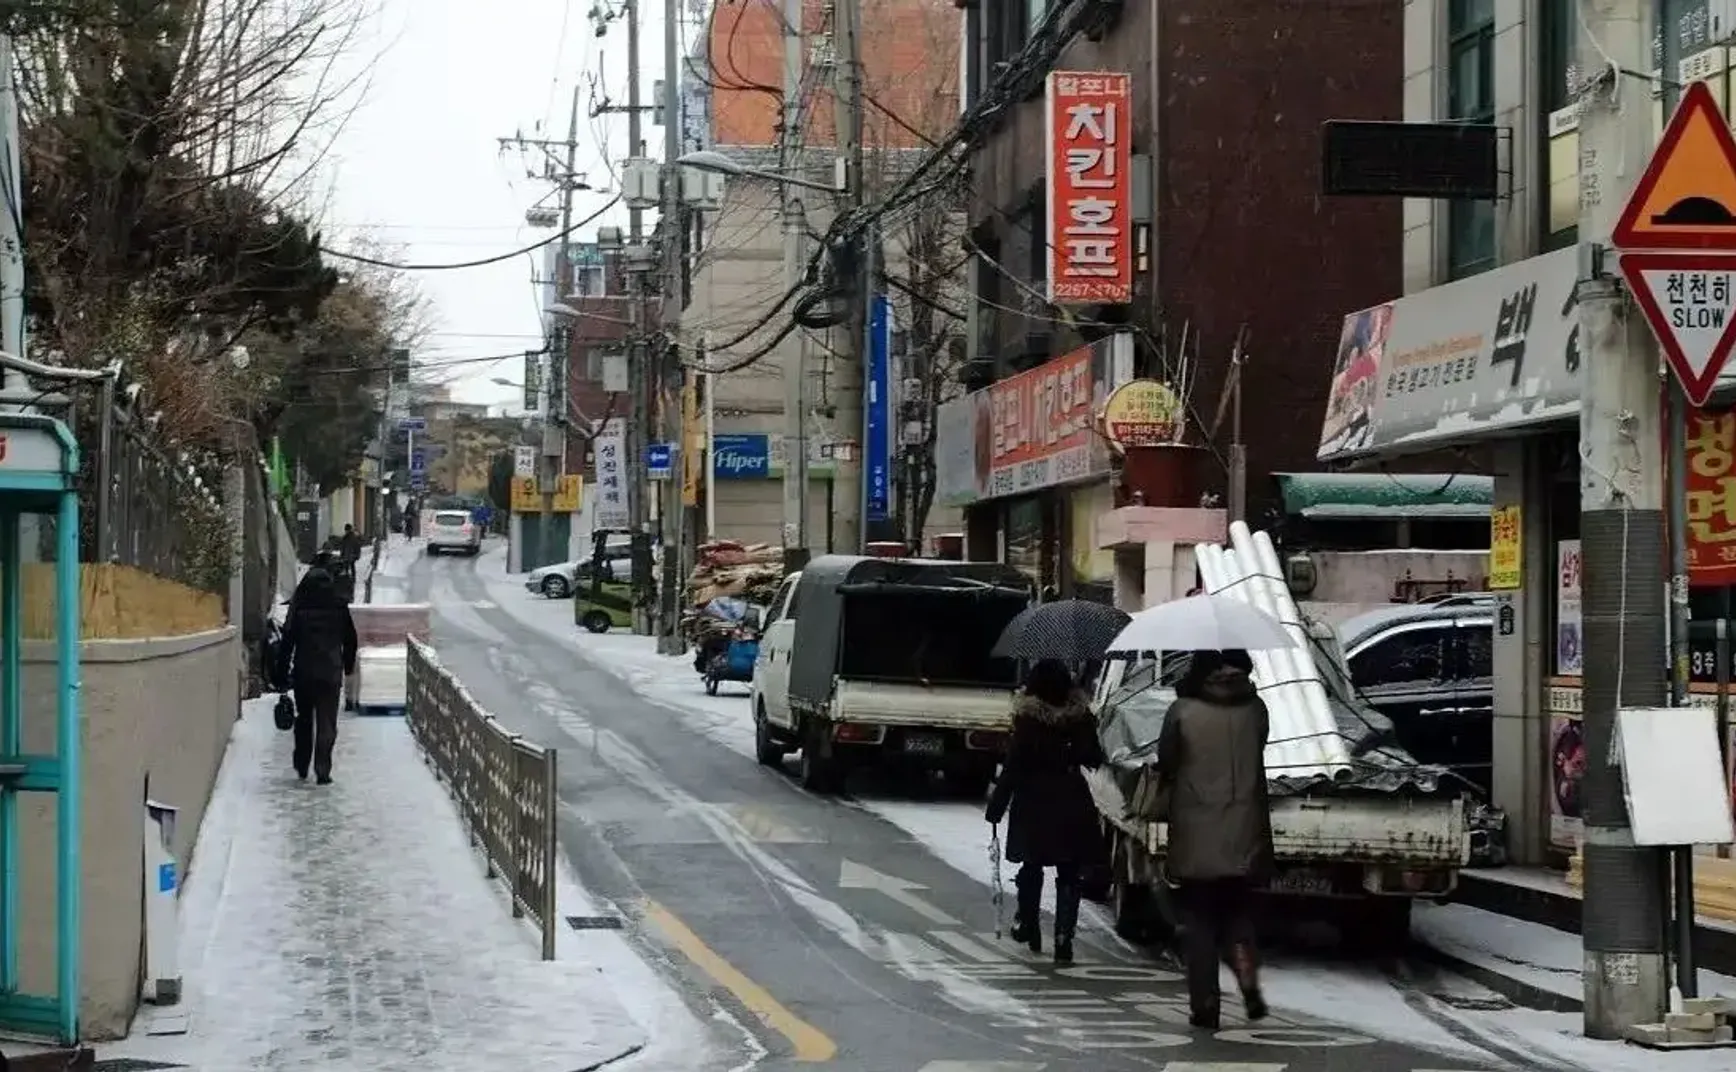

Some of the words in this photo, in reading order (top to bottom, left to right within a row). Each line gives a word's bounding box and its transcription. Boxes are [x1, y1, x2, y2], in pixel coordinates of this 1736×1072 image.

[1063, 102, 1120, 277] 치킨호프
[1667, 273, 1730, 305] 천천히
[1673, 308, 1724, 328] SLOW
[716, 452, 765, 472] Hiper
